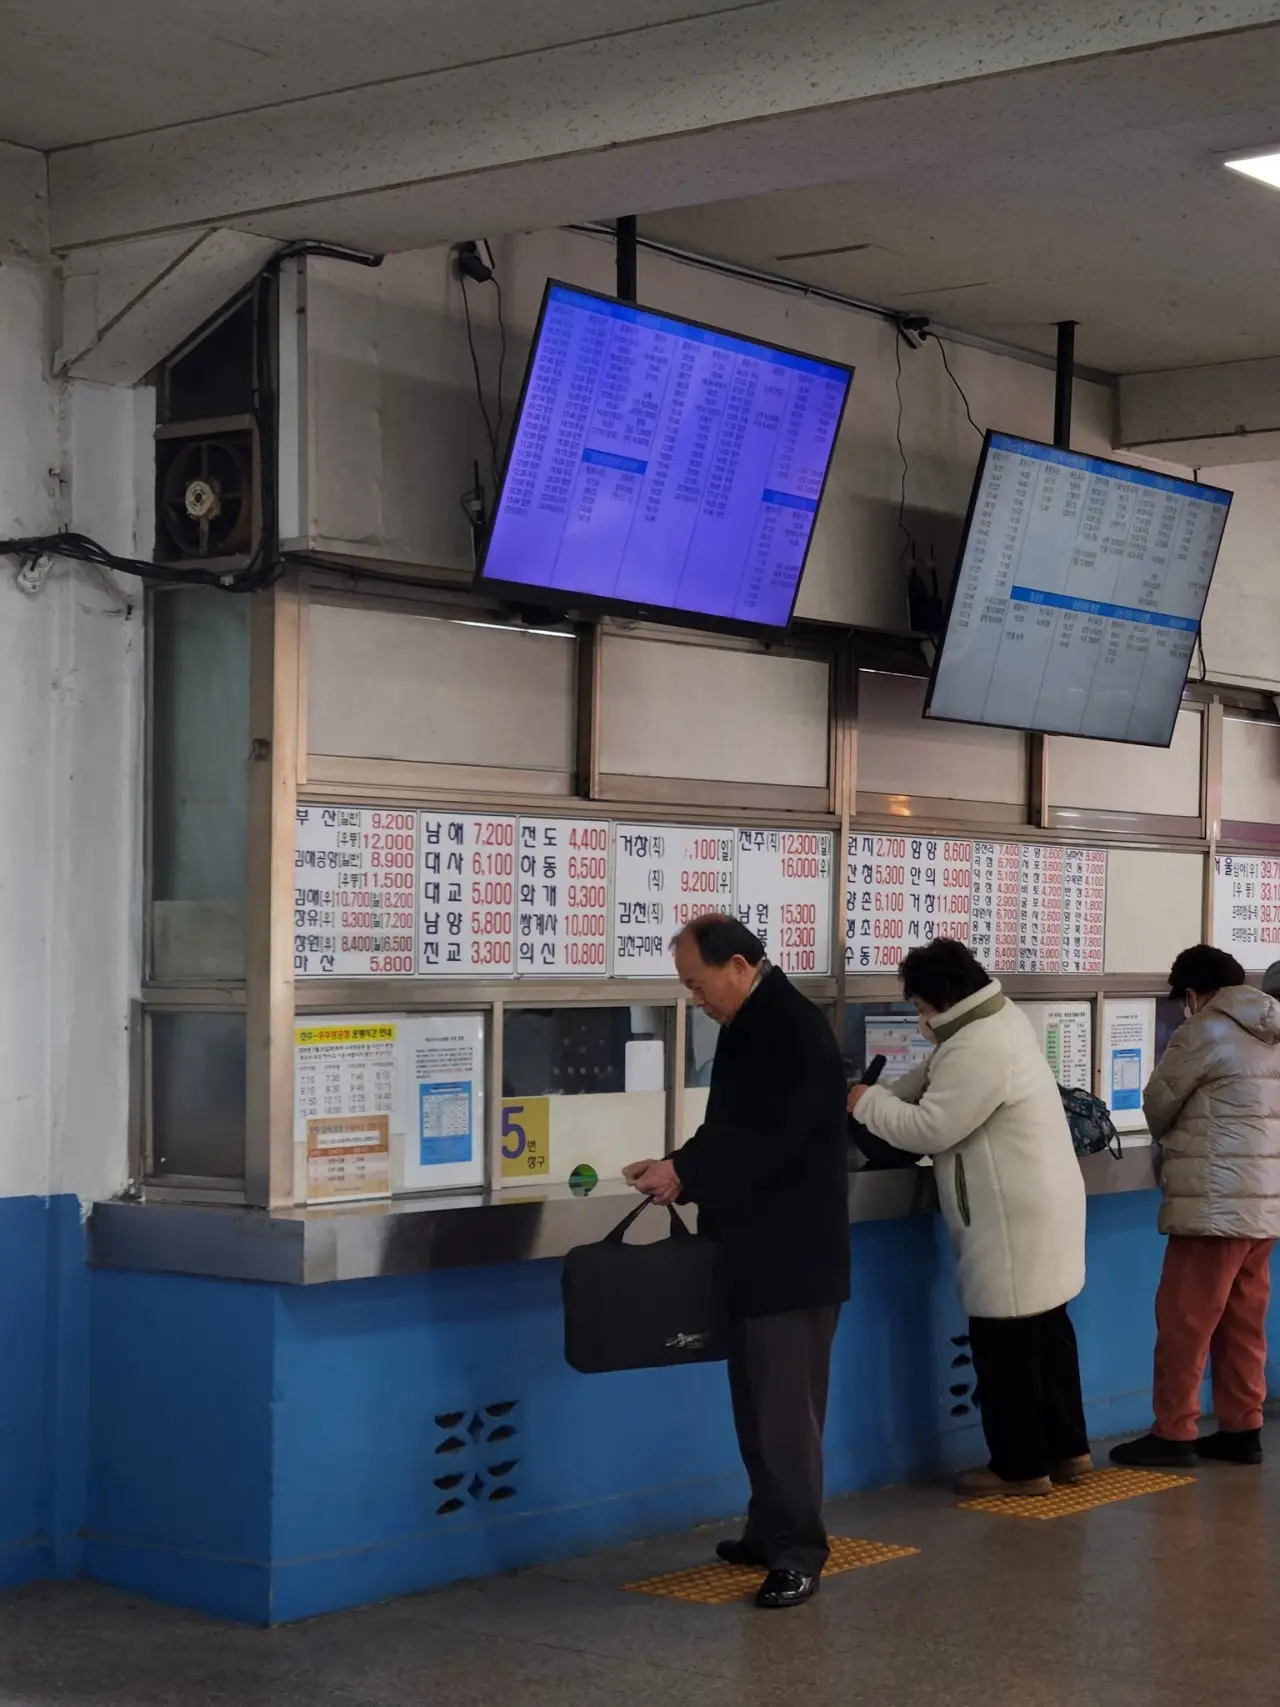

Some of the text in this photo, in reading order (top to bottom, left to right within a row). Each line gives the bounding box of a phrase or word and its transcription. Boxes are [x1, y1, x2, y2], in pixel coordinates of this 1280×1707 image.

[473, 823, 513, 846] 7,200
[568, 829, 607, 851] 4,400
[876, 838, 905, 858] 2,700
[943, 842, 971, 862] 8,600
[472, 852, 512, 876] 6,100
[568, 856, 606, 880] 6,500
[876, 865, 905, 885] 5,300
[943, 868, 970, 888] 9,900
[472, 882, 512, 905] 5,000
[568, 885, 606, 908] 9,300
[875, 891, 904, 912] 6,100
[779, 904, 816, 925] 15,300
[936, 895, 969, 914] 11,600
[471, 912, 511, 934] 5,800
[564, 914, 605, 936] 10,000
[874, 919, 903, 939] 6,800
[936, 921, 969, 941] 13,500
[617, 936, 662, 958] 김천구미역
[780, 927, 816, 948] 12,300
[471, 941, 511, 964] 3,300
[564, 943, 604, 965] 10,800
[874, 946, 902, 966] 7,800
[370, 956, 412, 972] 5,800
[501, 1106, 526, 1160] 5
[527, 1139, 537, 1153] 번
[527, 1156, 545, 1169] 창구
